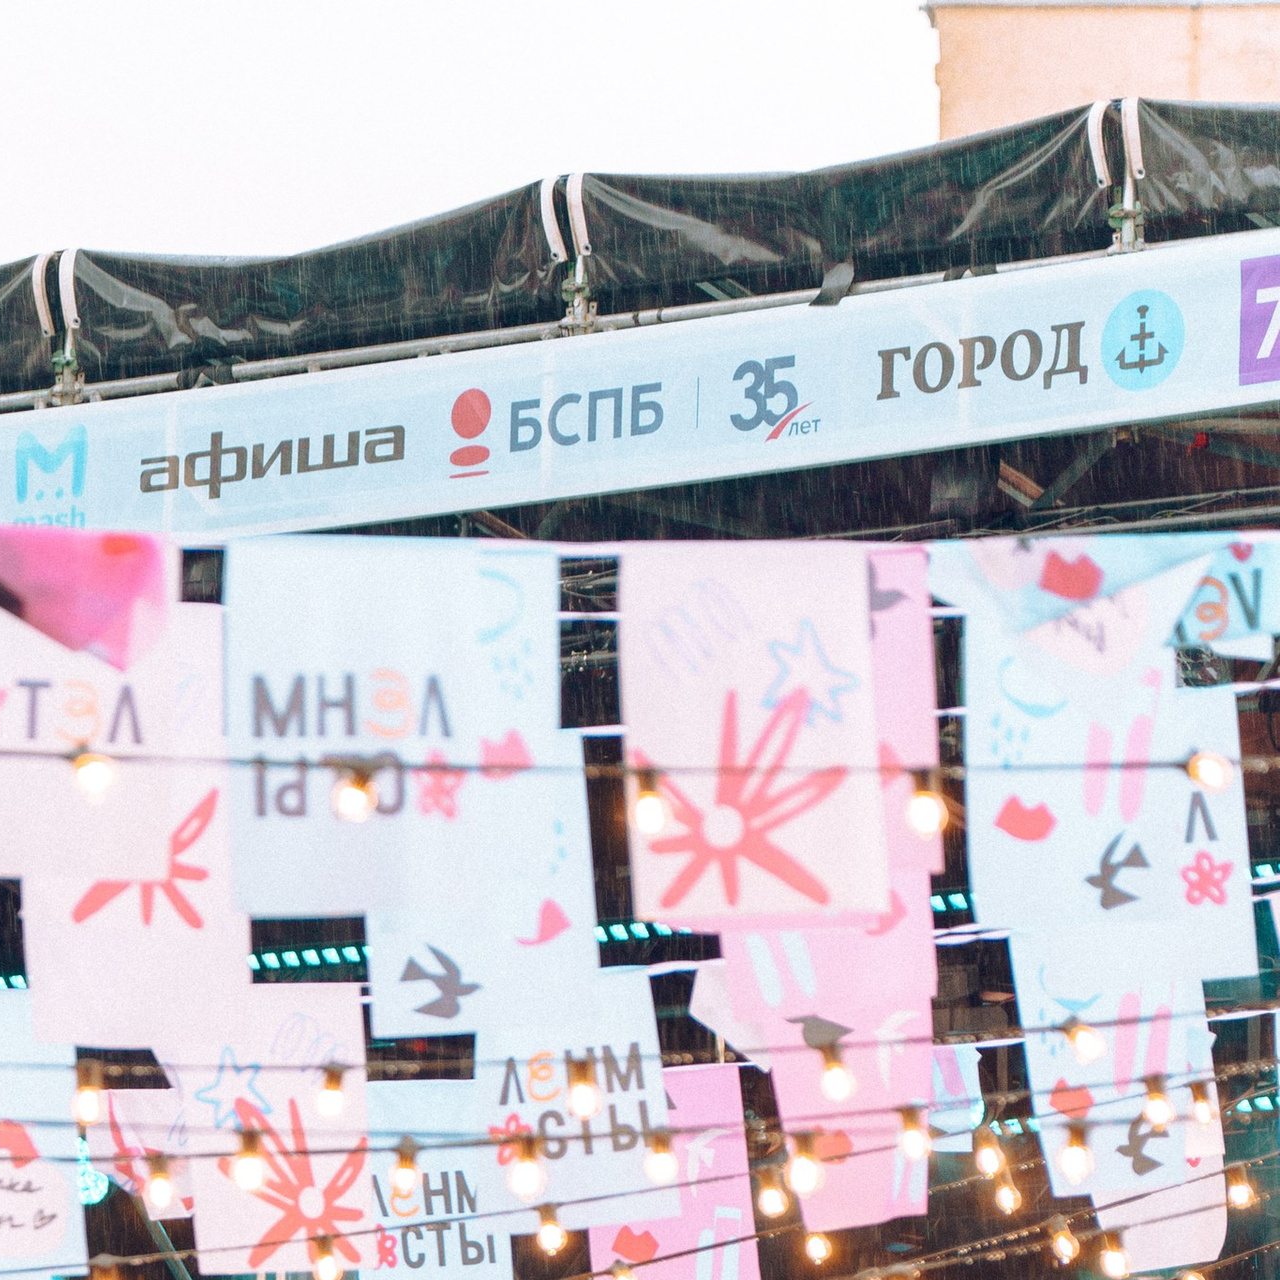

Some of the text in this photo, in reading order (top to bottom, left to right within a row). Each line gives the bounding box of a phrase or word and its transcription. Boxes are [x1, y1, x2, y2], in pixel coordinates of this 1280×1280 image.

[730, 355, 822, 437] 35 лет
[876, 319, 1089, 401] ГОРОД
[508, 381, 665, 453] БСПБ
[139, 424, 406, 500] афиша
